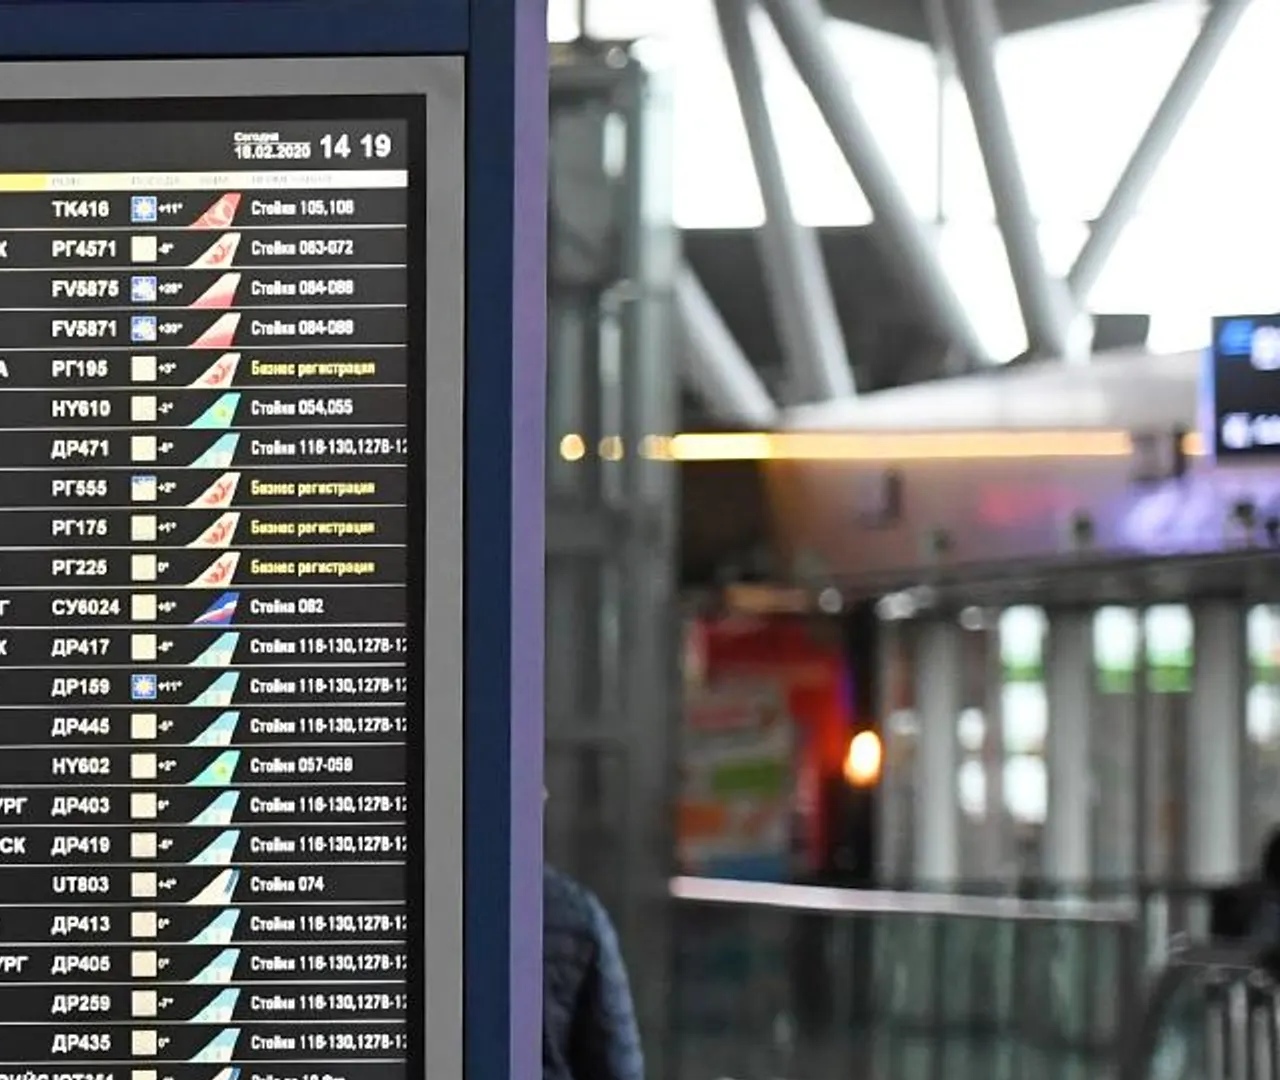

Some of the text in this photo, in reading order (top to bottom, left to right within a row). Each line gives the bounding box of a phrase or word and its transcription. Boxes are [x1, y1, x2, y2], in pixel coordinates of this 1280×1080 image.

[234, 143, 311, 159] 18.02.2020
[320, 134, 391, 158] 14 19
[52, 240, 115, 257] РГ4571
[51, 440, 108, 459] ДР471
[53, 480, 107, 496] РГ555
[53, 559, 107, 575] РГ225
[51, 639, 109, 657] ДР417
[52, 718, 109, 736] ДР445
[51, 797, 109, 816] ДР403
[53, 877, 109, 892] UT803
[299, 876, 324, 891] 074
[51, 916, 110, 935] ДР413
[52, 1034, 110, 1053] ДР435
